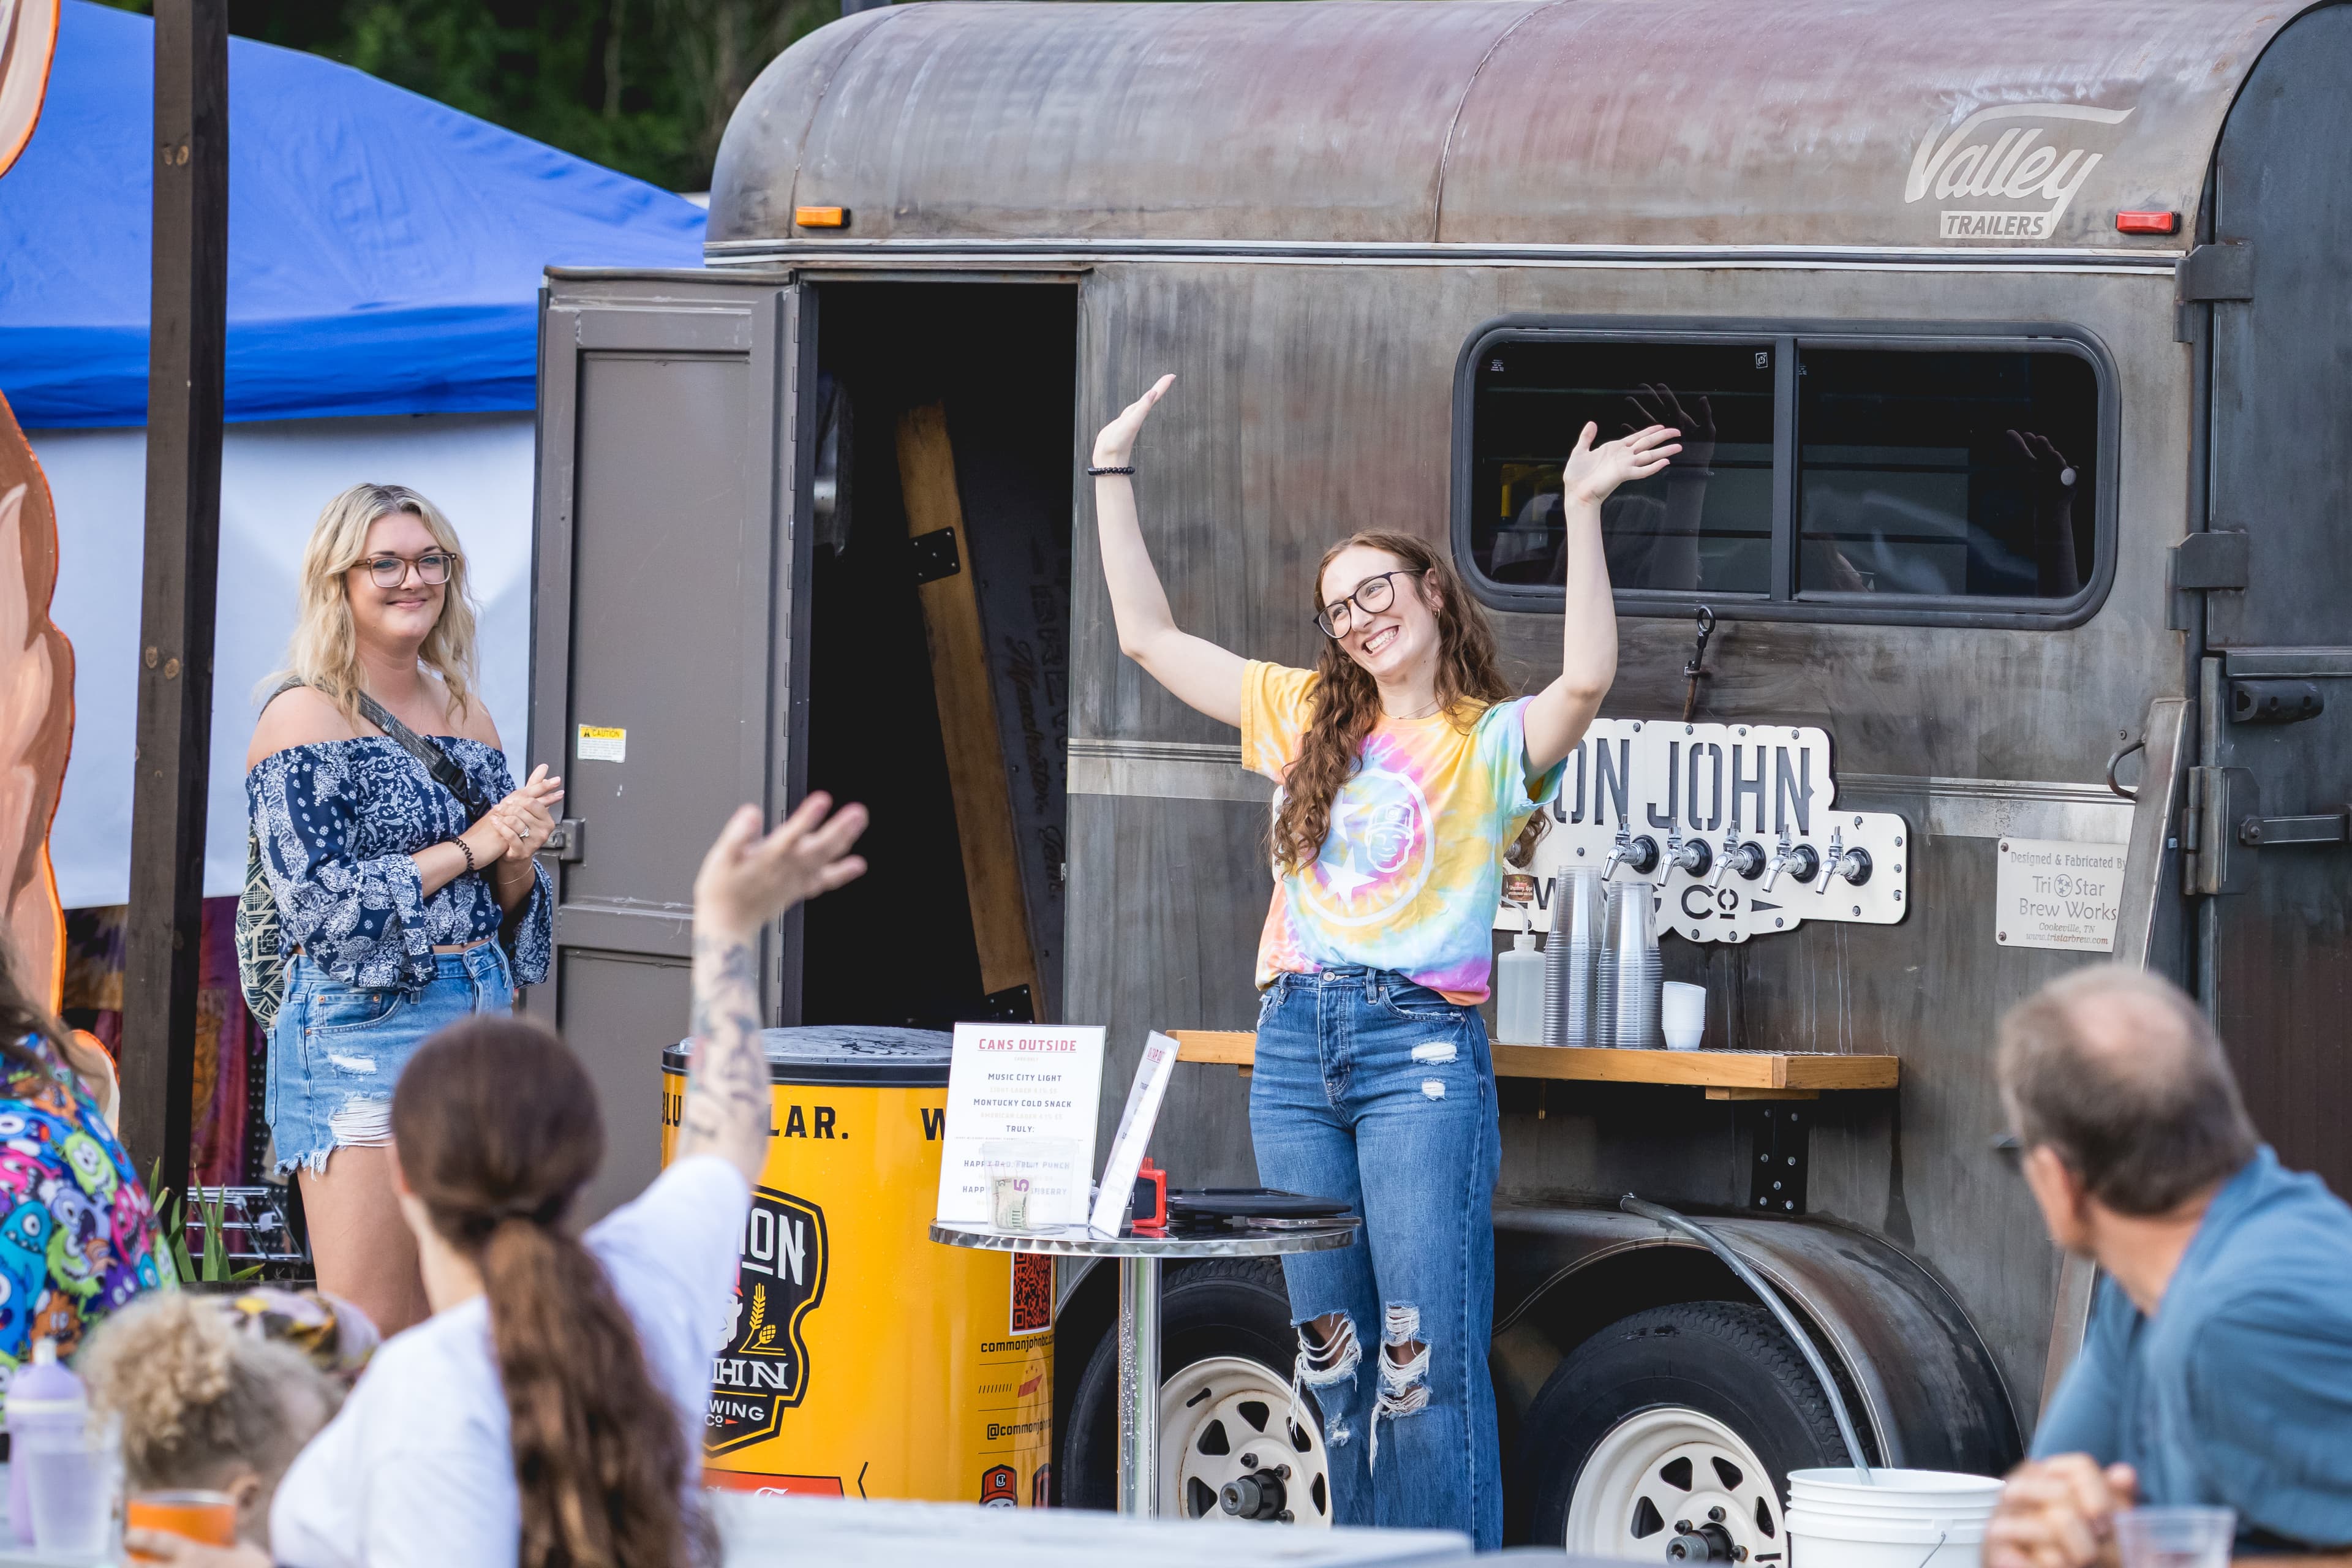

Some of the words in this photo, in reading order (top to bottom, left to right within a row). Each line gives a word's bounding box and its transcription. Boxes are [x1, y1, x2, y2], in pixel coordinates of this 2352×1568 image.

[1904, 103, 2136, 208] Valley
[1947, 215, 2045, 236] TRAILERS
[592, 729, 620, 738] CAUTION
[1647, 740, 1814, 837] JOHN
[2010, 851, 2052, 867] Designed
[2055, 854, 2062, 865] &
[2065, 854, 2113, 869] Fabricated
[2032, 875, 2051, 894] Tri
[2075, 878, 2106, 897] Star
[2019, 897, 2060, 918] Brew
[2065, 900, 2117, 921] Works
[2026, 932, 2109, 945] www.tristarbrew.com
[2038, 922, 2081, 934] Cookeville,
[979, 1038, 1014, 1050] CANS
[1019, 1039, 1077, 1052] OUTSIDE
[973, 1098, 1019, 1107] MONTUCKY
[766, 1104, 849, 1140] LAR.
[920, 1107, 946, 1140] W
[739, 1207, 806, 1286] ON
[710, 1357, 789, 1390] HN
[708, 1399, 765, 1421] WING
